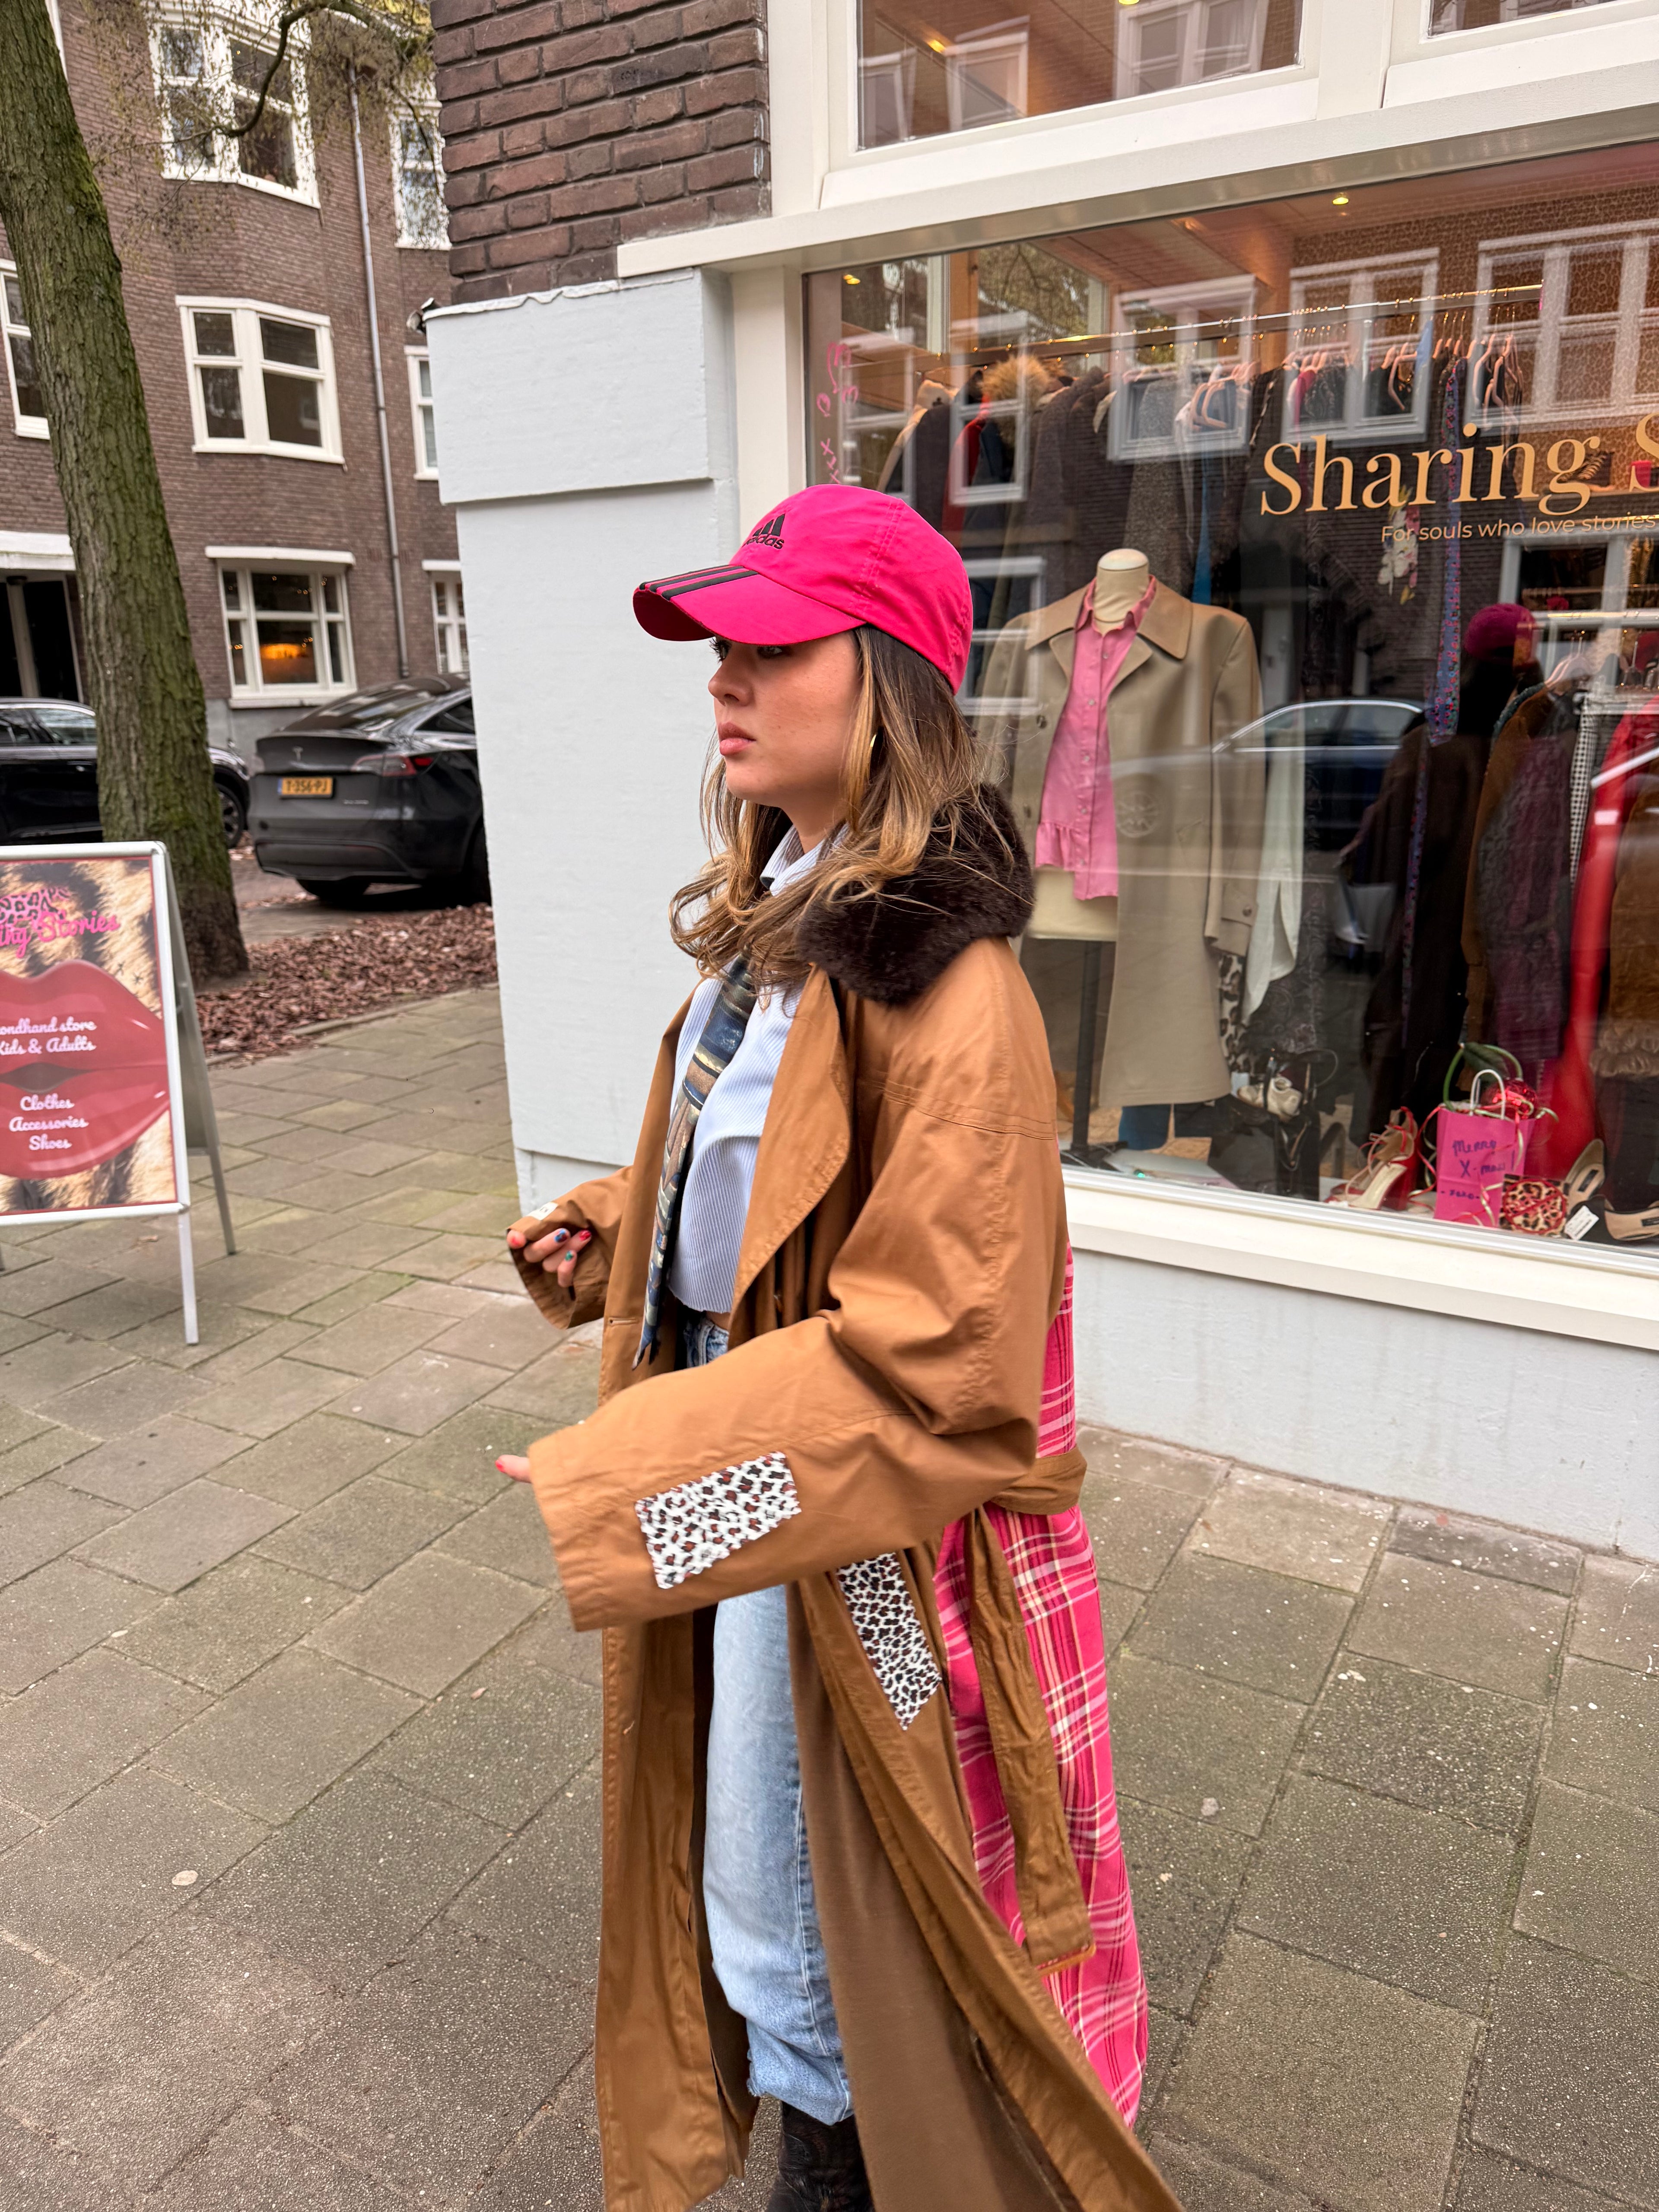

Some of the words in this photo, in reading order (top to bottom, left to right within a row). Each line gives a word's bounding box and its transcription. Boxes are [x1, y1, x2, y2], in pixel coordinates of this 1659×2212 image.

[1261, 422, 1600, 515] Sharing
[1381, 525, 1414, 543] For
[1418, 521, 1473, 540] souls
[1478, 518, 1525, 537] who
[1532, 517, 1575, 534] love
[1581, 512, 1656, 532] stories
[38, 909, 121, 943] Stories
[59, 1016, 97, 1033] store
[28, 1038, 42, 1054] &
[46, 1035, 97, 1053] Adults
[20, 1093, 75, 1111] Clothes
[9, 1115, 89, 1132] Accessories
[29, 1133, 73, 1150] Shoes
